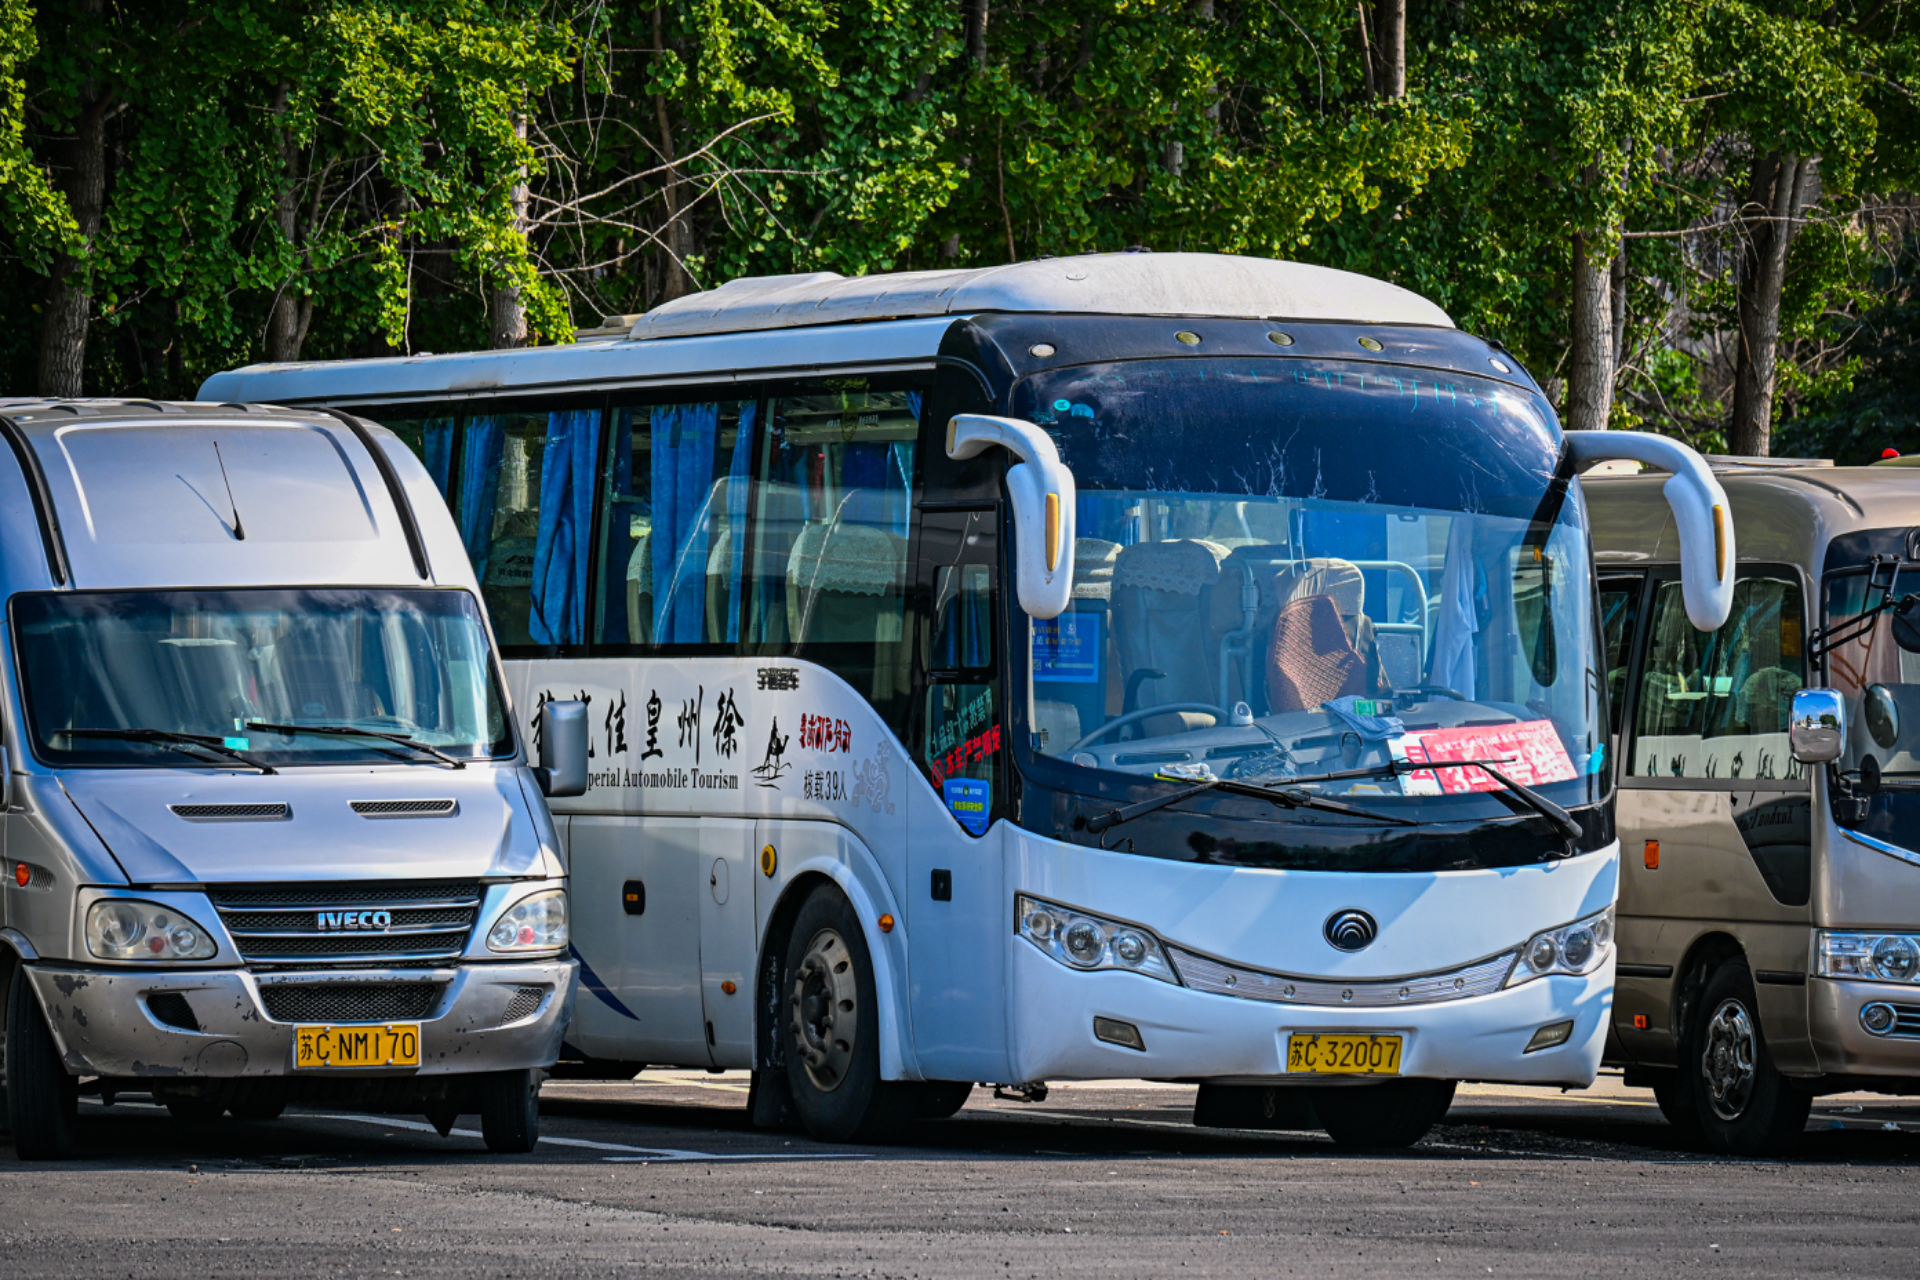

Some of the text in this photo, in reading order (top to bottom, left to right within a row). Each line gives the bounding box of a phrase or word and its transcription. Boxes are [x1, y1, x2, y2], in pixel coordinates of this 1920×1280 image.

[587, 767, 738, 790] perial Automobile Tourism
[803, 770, 848, 801] 核载39人
[318, 911, 391, 931] IVECO
[1290, 1041, 1398, 1068] 苏C·32007
